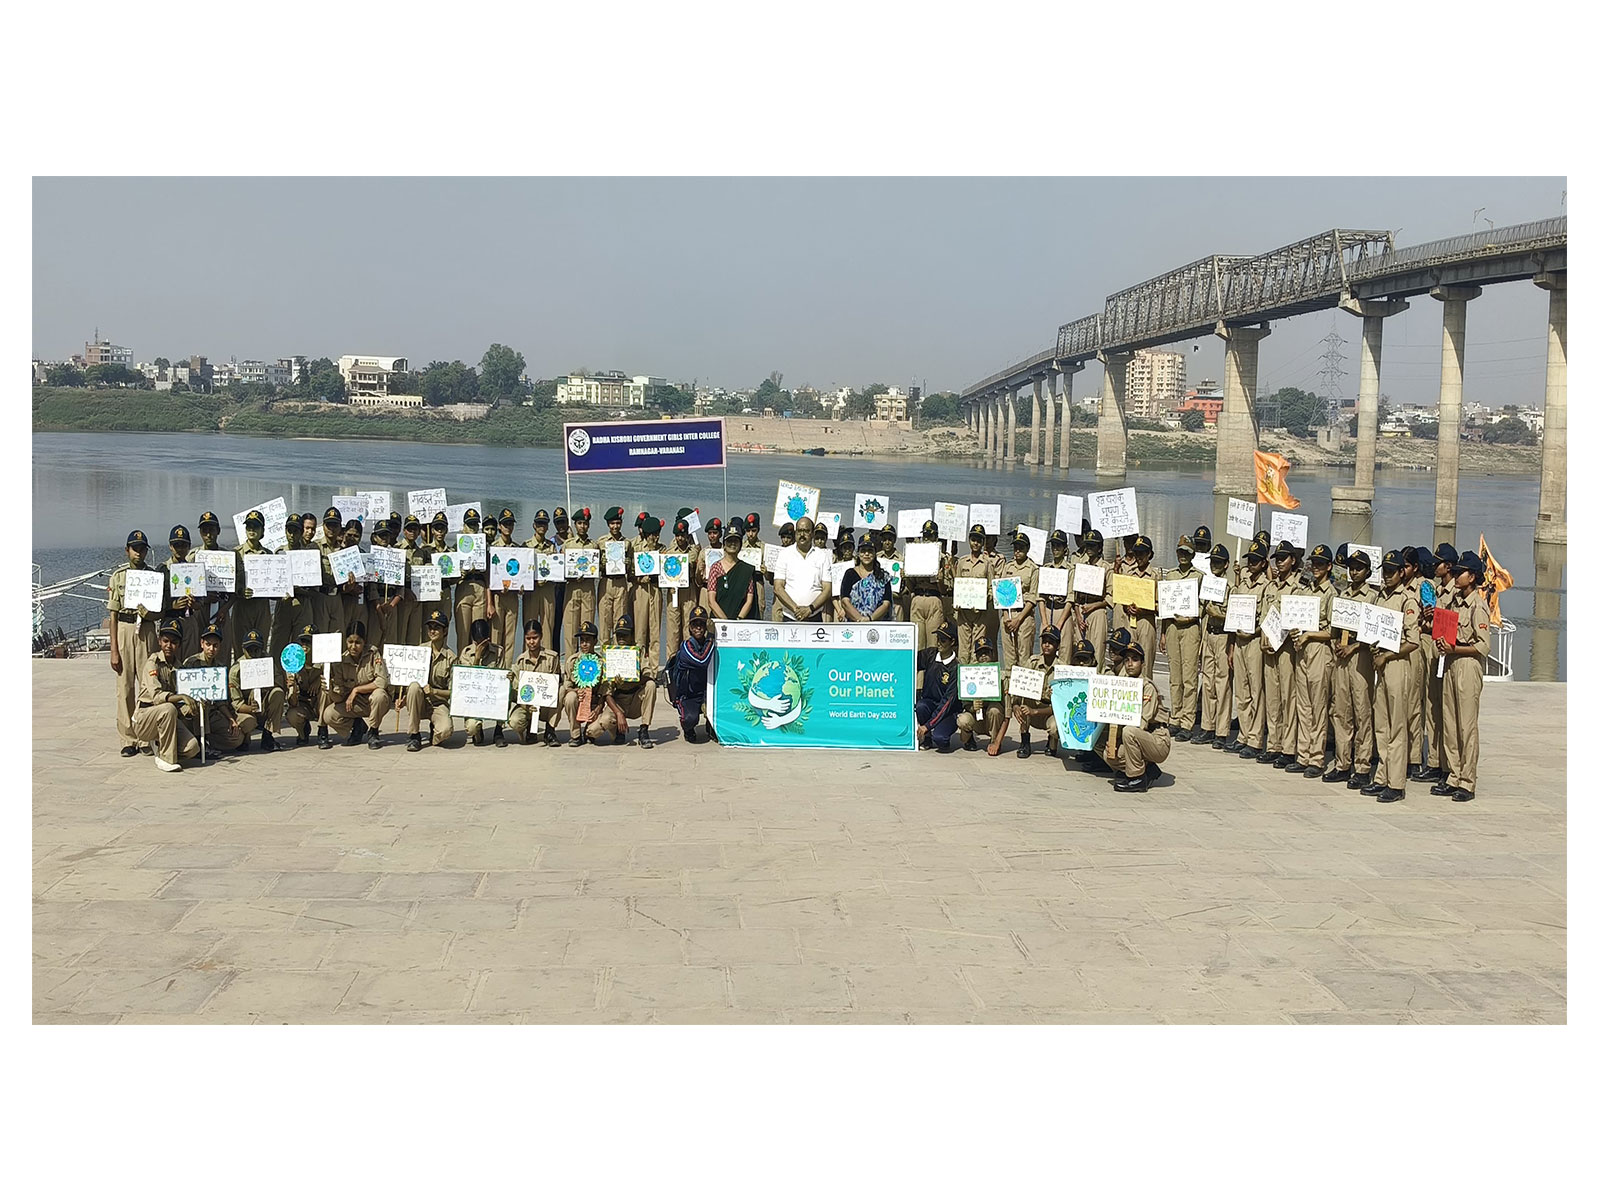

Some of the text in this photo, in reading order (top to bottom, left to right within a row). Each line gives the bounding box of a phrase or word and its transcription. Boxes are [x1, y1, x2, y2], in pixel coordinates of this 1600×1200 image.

[633, 433, 667, 442] GOVERNMENT
[667, 433, 683, 441] GIRLS
[699, 431, 720, 439] COLLEGE
[828, 669, 897, 684] Our Power,
[829, 685, 895, 698] Our Planet
[1092, 688, 1139, 702] OUR POWER
[1092, 699, 1142, 714] OUR PLANET
[828, 710, 848, 718] World
[867, 711, 880, 720] Day
[881, 711, 897, 719] 2026
